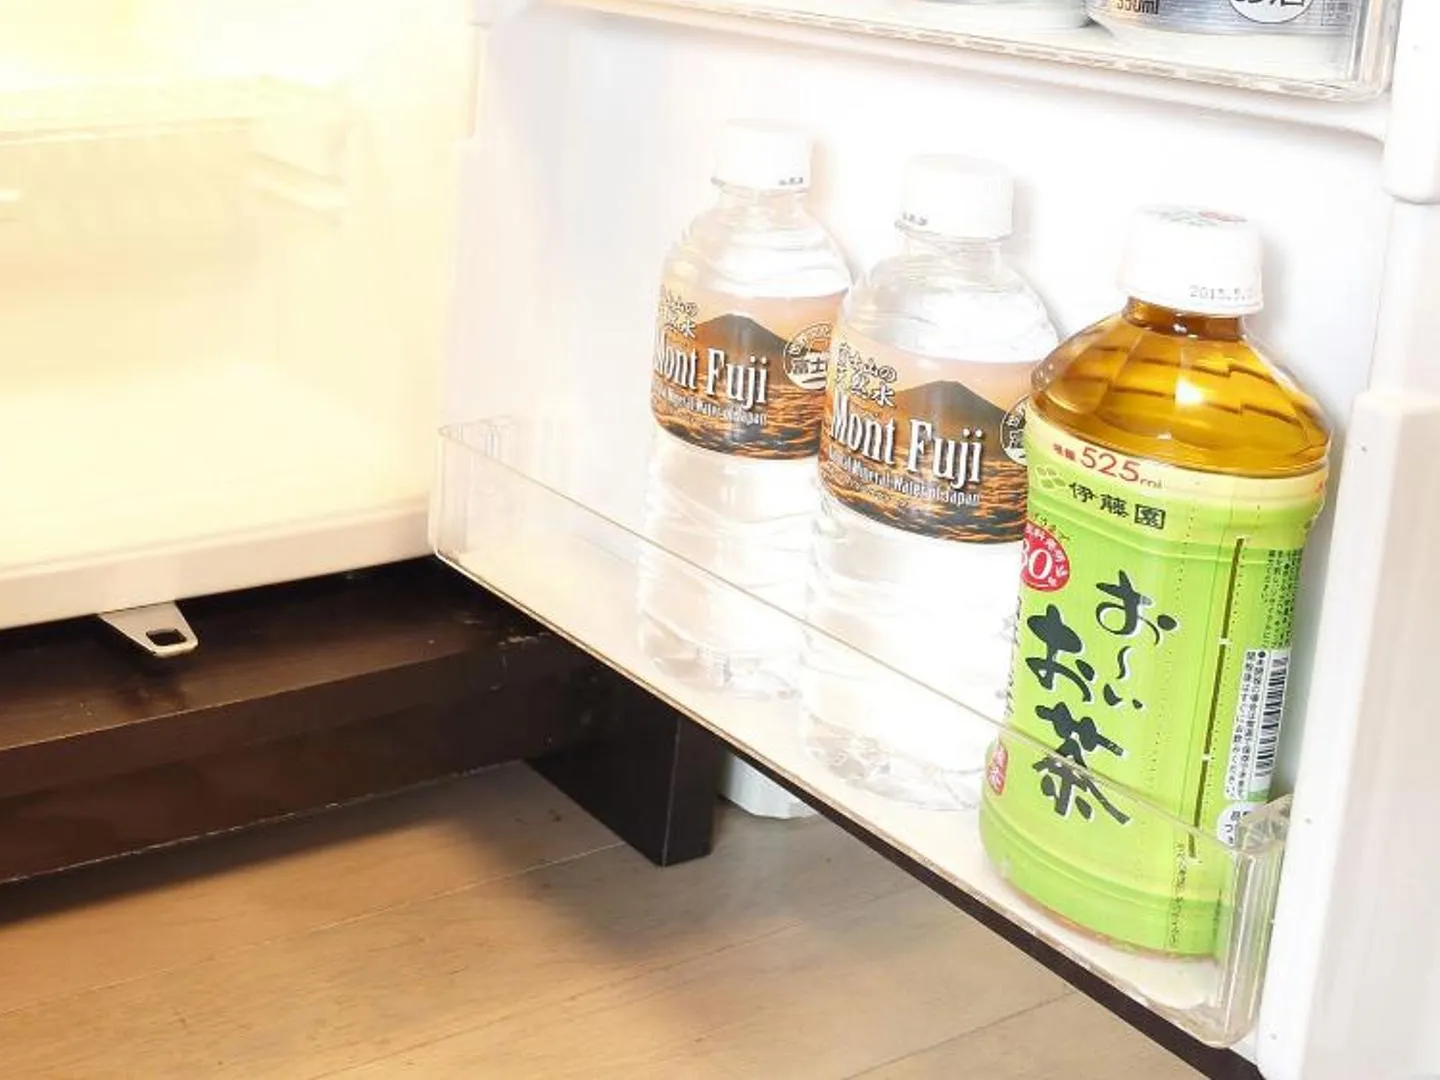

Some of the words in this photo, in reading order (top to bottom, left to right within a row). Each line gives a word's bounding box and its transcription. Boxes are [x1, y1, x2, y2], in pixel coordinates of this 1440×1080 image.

[704, 347, 769, 411] Fuji
[830, 390, 896, 466] Mont
[906, 418, 985, 490] Fuji
[1068, 481, 1166, 531] 伊藤園
[1025, 602, 1132, 827] お茶
